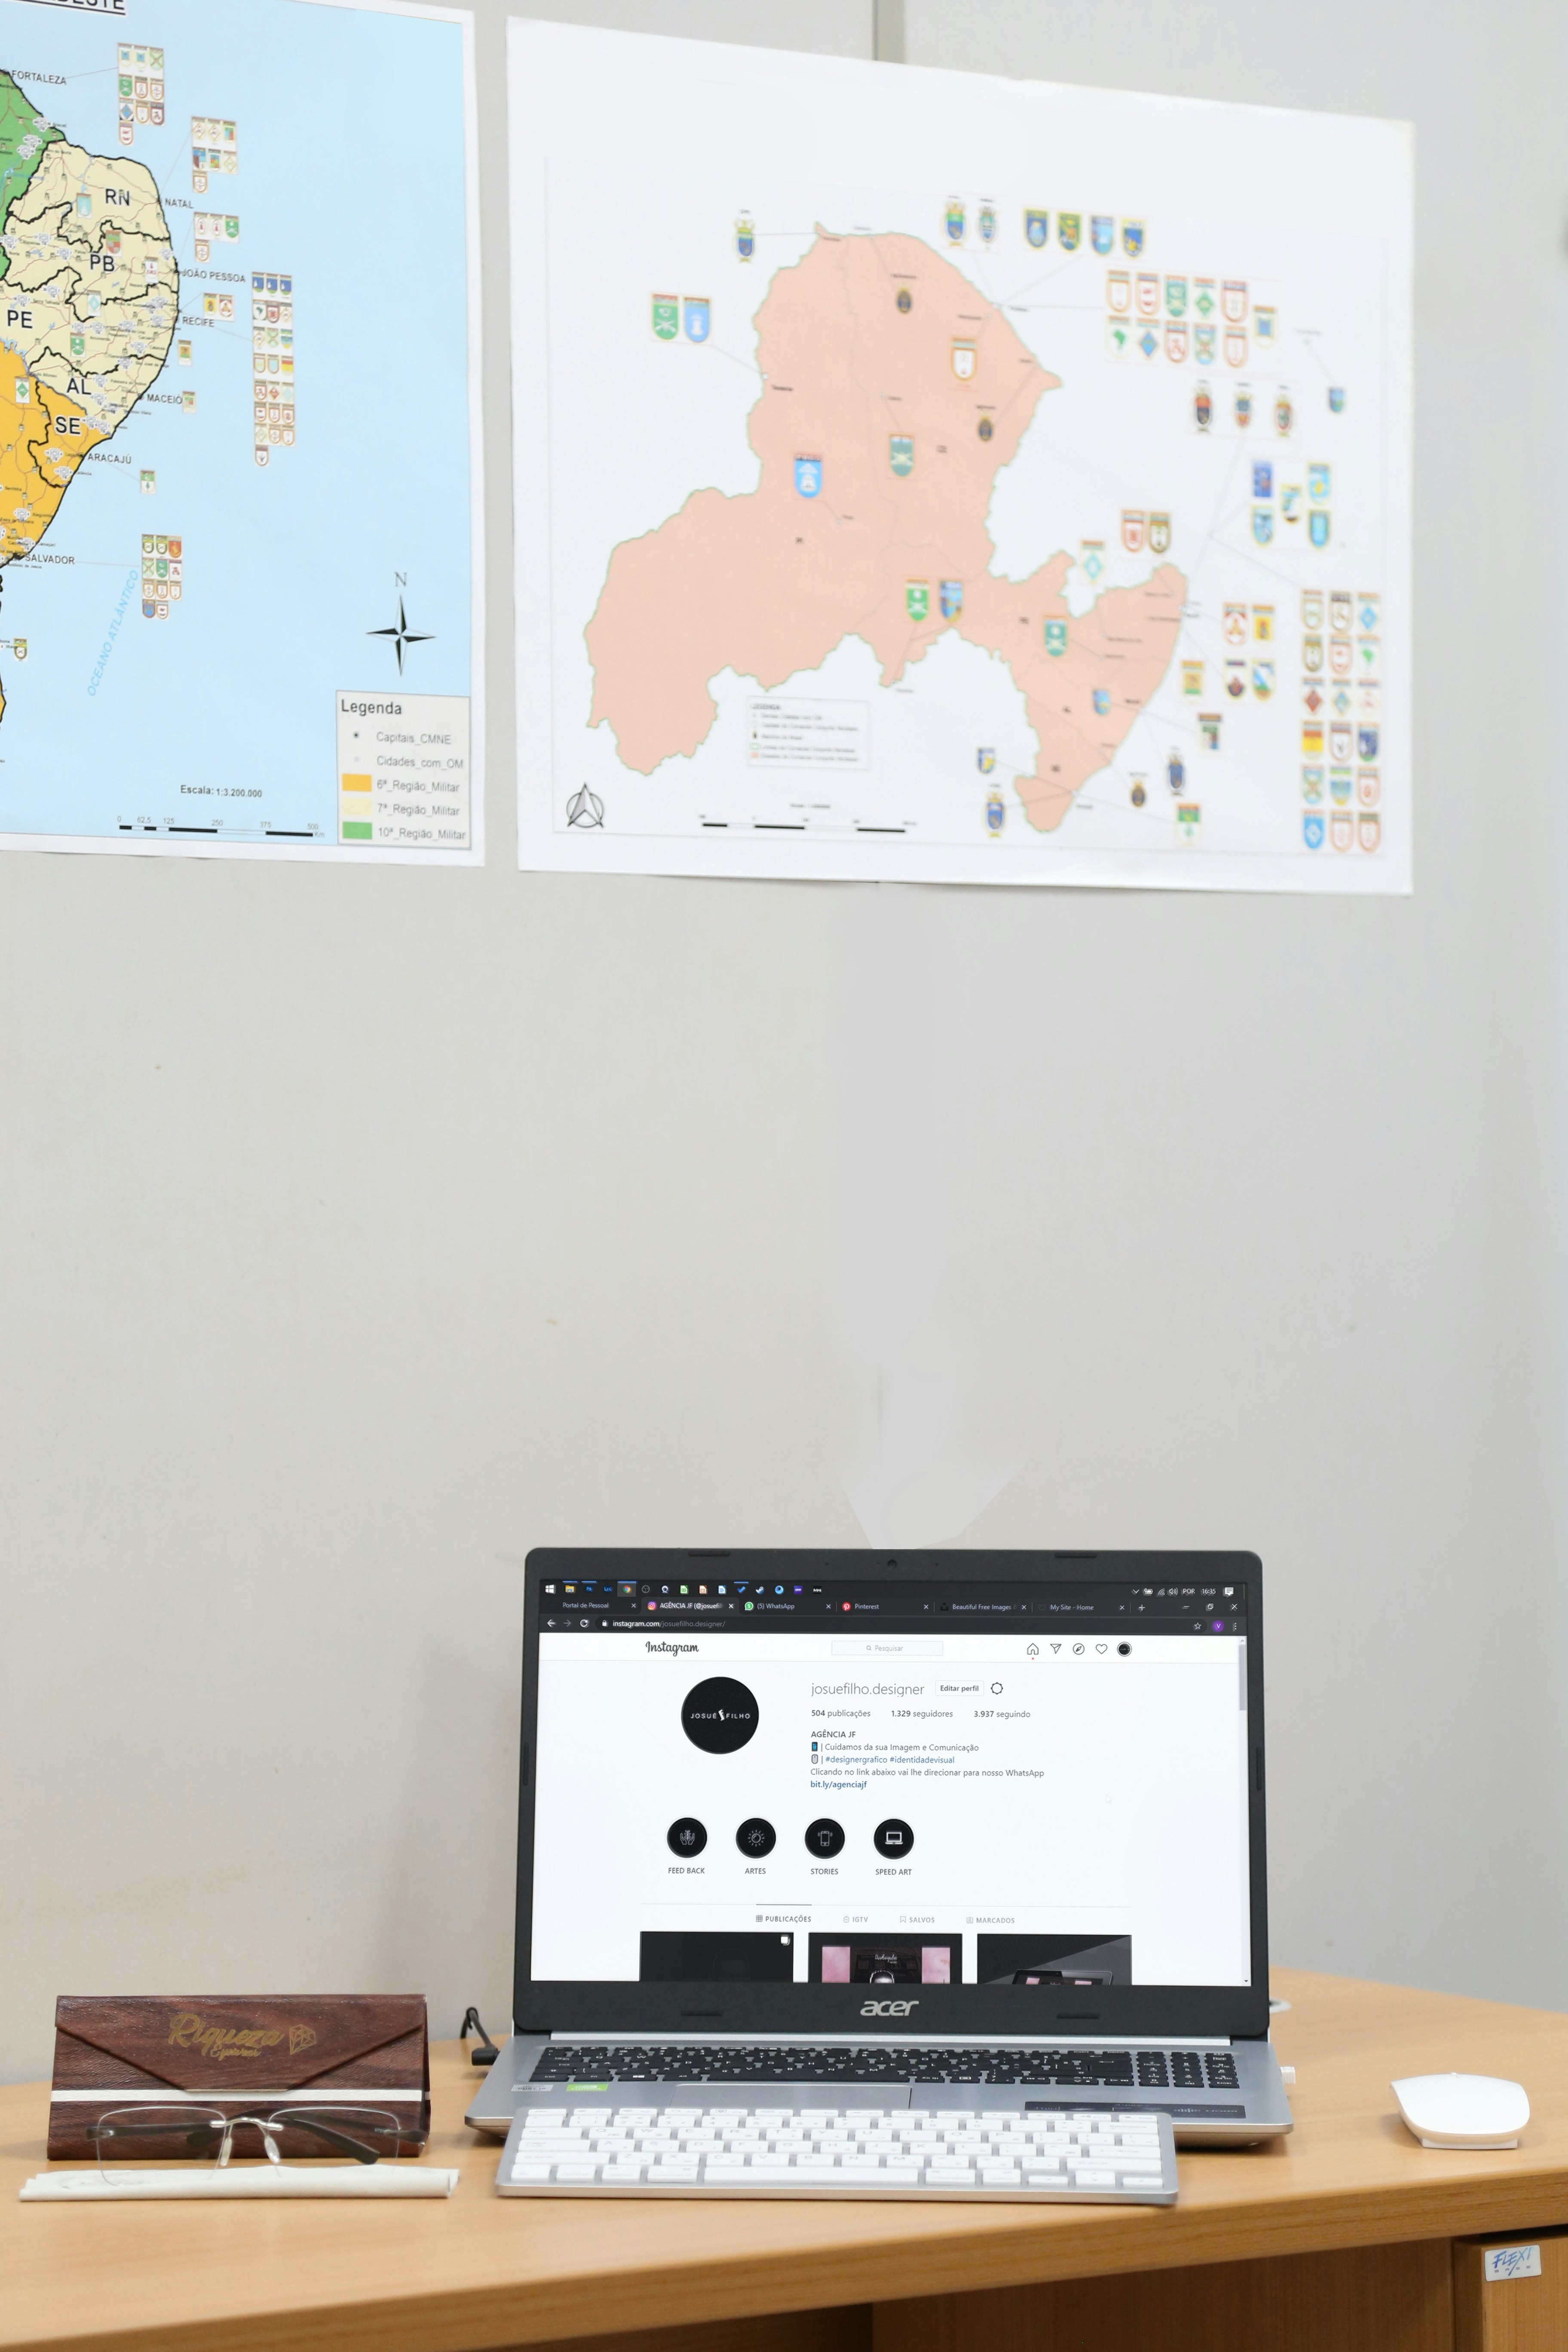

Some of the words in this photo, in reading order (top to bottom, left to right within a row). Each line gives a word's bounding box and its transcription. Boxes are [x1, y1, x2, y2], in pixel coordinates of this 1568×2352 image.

[12, 70, 67, 85] FORTALEZA
[106, 188, 130, 206] RN
[165, 198, 194, 208] NATAL
[90, 254, 115, 271] PB
[181, 268, 207, 279] JOÃO
[209, 271, 246, 283] PESSOA
[7, 309, 33, 328] PE
[183, 316, 215, 327] RECIFE
[67, 378, 92, 395] AL
[147, 394, 183, 404] MACEIÓ
[55, 416, 81, 435] SE
[88, 453, 132, 464] ARACAJÚ
[25, 554, 75, 565] SALVADOR
[394, 572, 407, 587] N
[87, 642, 112, 696] OCEANO
[107, 570, 138, 642] ATLÂNTICO
[341, 699, 402, 716] Legenda
[376, 732, 451, 746] Capitais_CMNE
[377, 755, 463, 769] Cidades_com_OM
[181, 784, 214, 795] Escala:
[216, 788, 262, 797] 1:3.200.000
[612, 1620, 726, 1629] instagram.com/josuefilho.designer/
[645, 1641, 699, 1657] Instagram
[812, 1683, 925, 1697] josuefilho.designer
[827, 1709, 871, 1718] publicações
[913, 1710, 953, 1719] seguidores
[996, 1710, 1031, 1719] seguindo
[811, 1729, 846, 1738] AGÊNCIA
[890, 1744, 920, 1752] Imagem
[929, 1744, 979, 1753] Comunicação
[825, 1756, 888, 1764] #designergrafico
[1006, 1769, 1044, 1778] WhatsApp
[811, 1781, 867, 1790] bit.ly/agenciajf
[766, 1915, 812, 1923] PUBLICAÇÕES
[860, 2001, 919, 2016] acer
[168, 2014, 285, 2056] Riqueza
